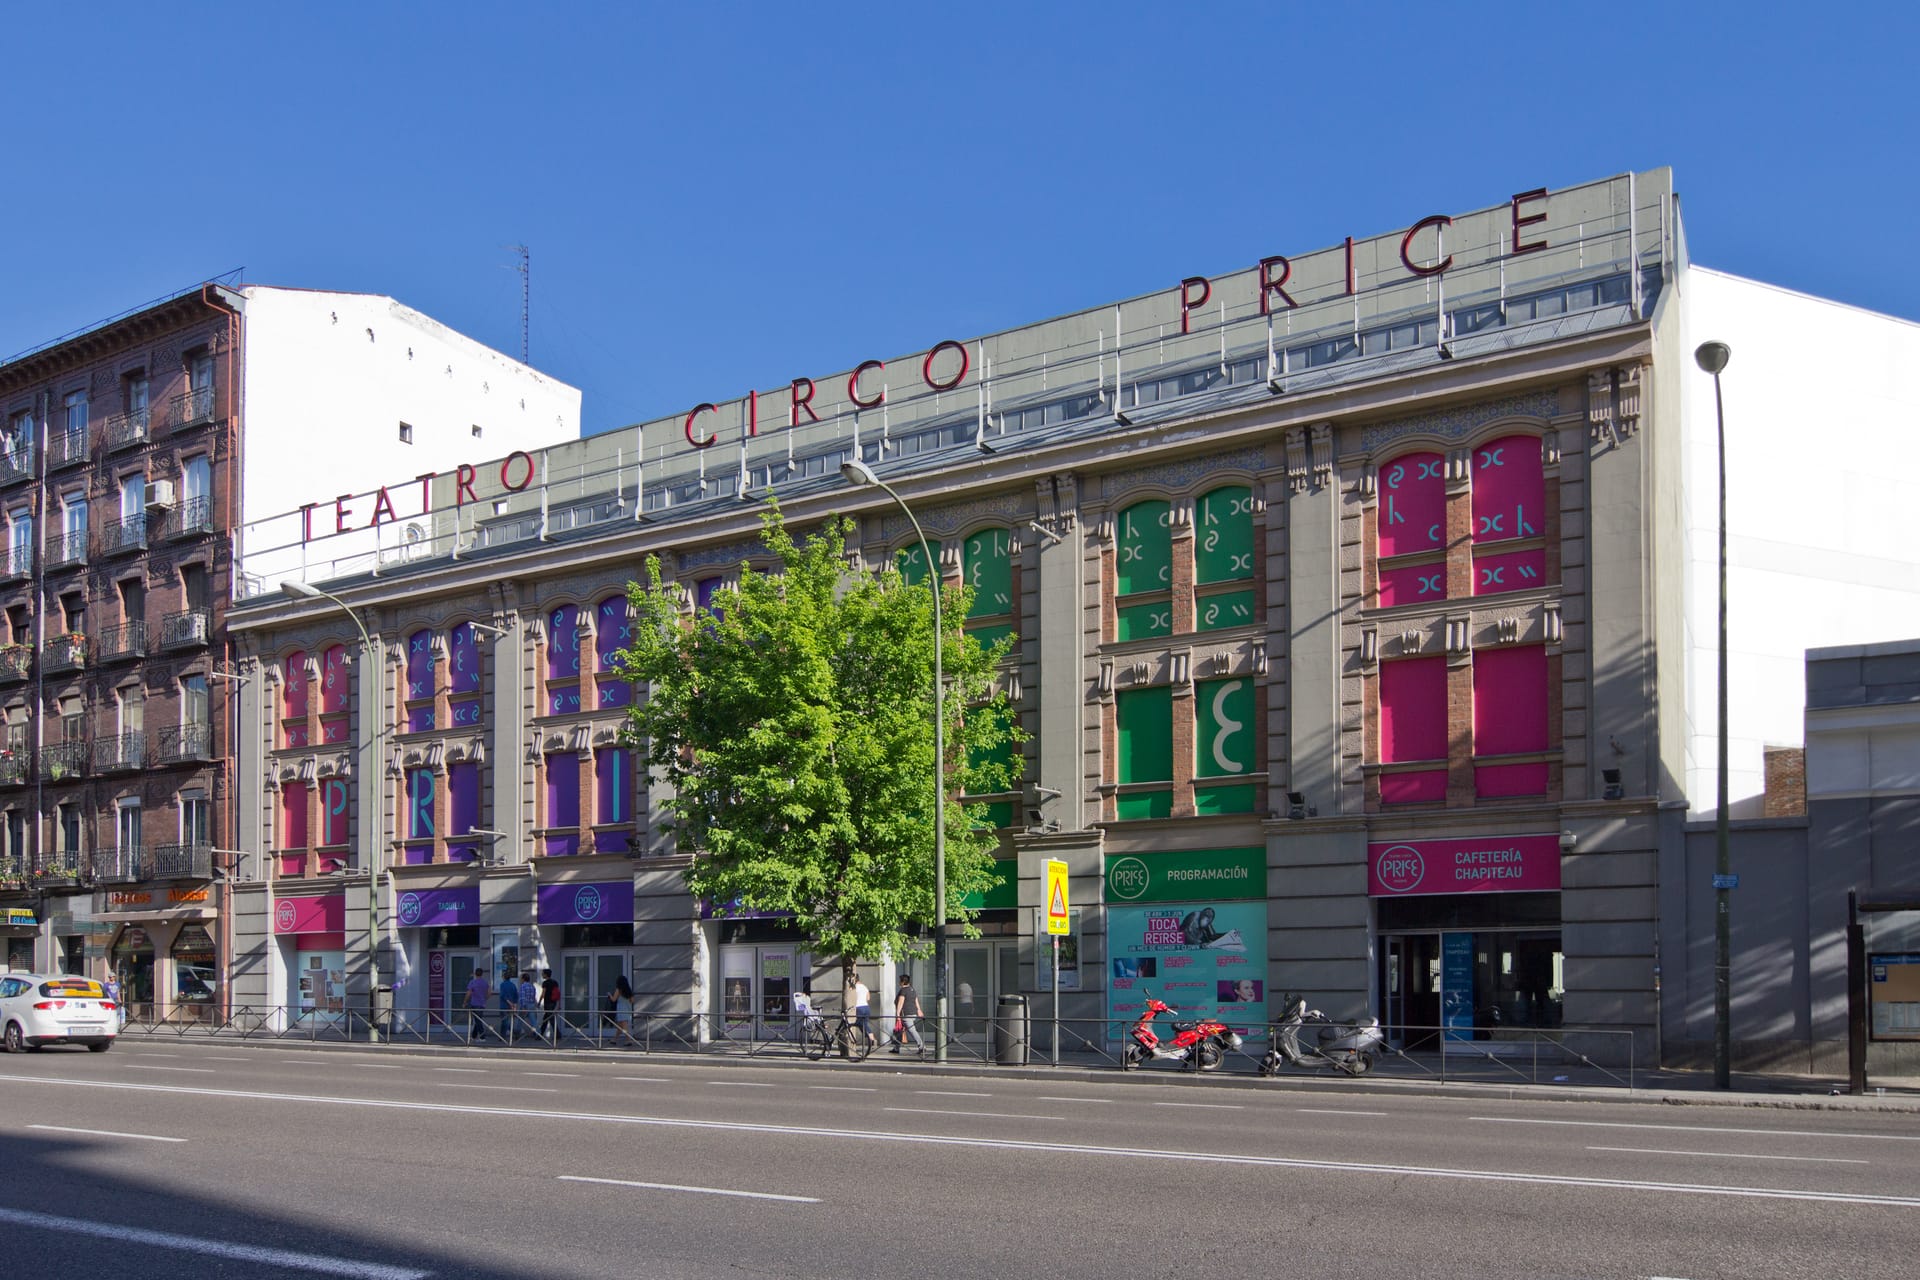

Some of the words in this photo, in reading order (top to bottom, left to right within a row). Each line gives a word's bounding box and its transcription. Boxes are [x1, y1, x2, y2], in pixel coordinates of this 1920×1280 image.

[299, 451, 535, 541] TEATRO
[685, 340, 970, 448] CIRCO
[1181, 187, 1549, 334] PRICE
[1455, 848, 1523, 865] CAFETERÍA
[1167, 865, 1248, 881] PROGRAMACIÓN
[1455, 866, 1523, 880] CHAPITEAU
[438, 901, 465, 910] TAQUILLA
[1150, 918, 1178, 930] TOCA
[1145, 932, 1185, 944] REÍRSE
